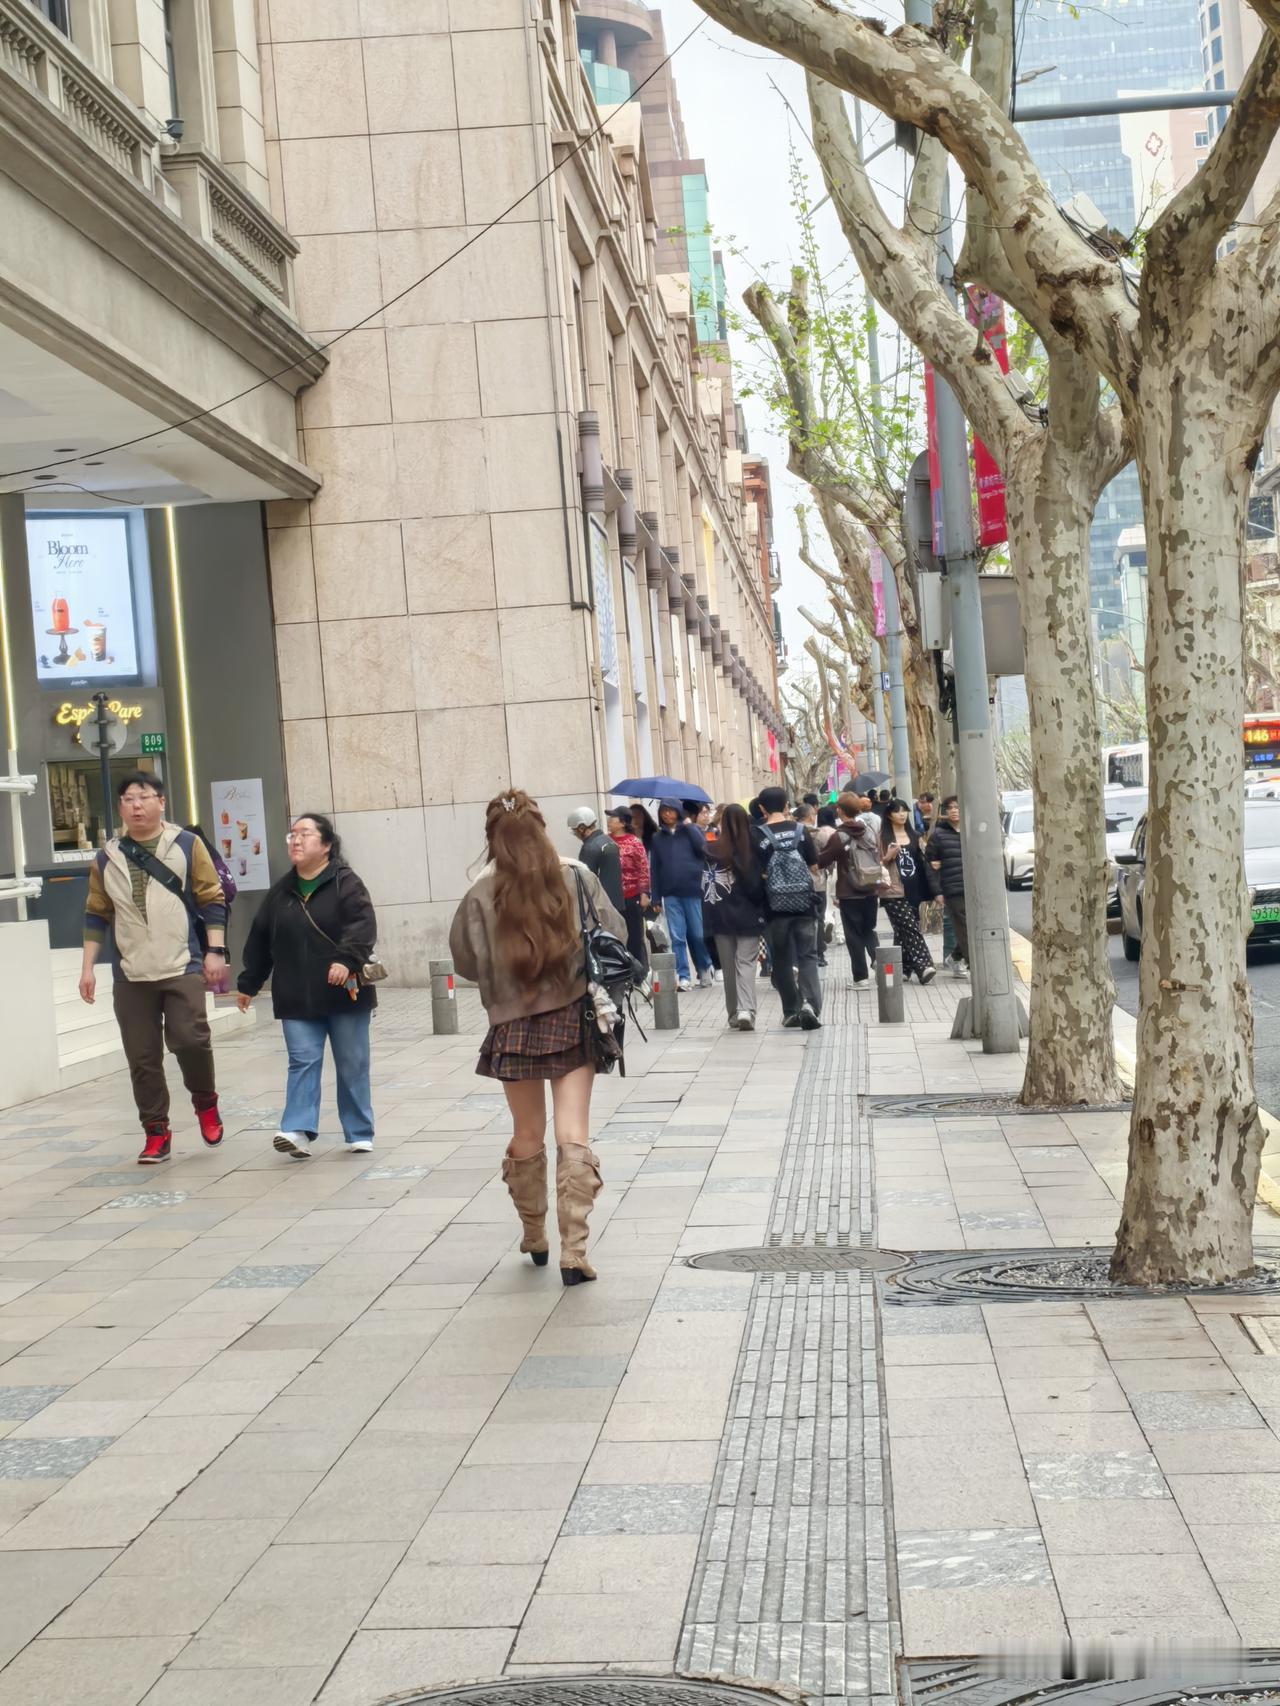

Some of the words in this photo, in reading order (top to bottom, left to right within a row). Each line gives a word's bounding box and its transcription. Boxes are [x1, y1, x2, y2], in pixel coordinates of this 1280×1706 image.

[47, 540, 88, 557] Bloom
[144, 735, 162, 746] 809
[1247, 729, 1269, 743] 146
